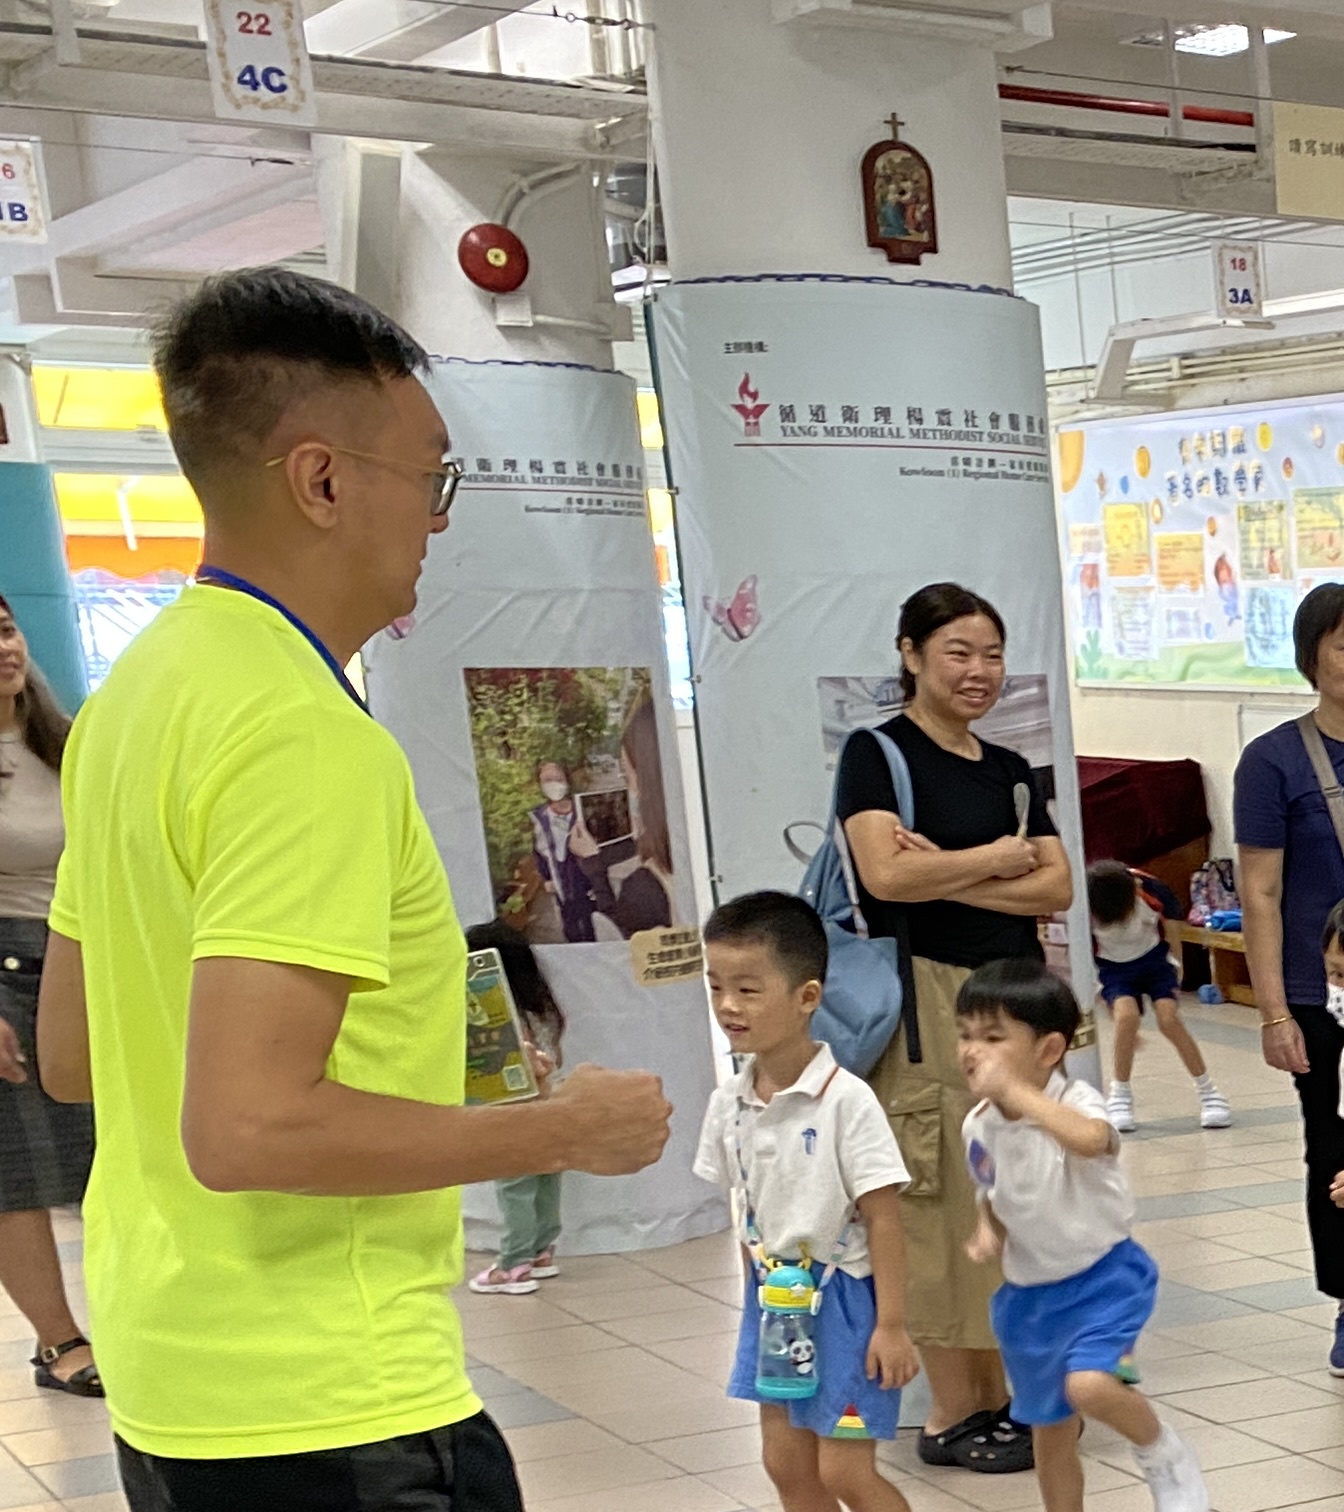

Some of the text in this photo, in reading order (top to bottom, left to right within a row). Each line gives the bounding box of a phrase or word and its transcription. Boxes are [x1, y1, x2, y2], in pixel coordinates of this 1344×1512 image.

[236, 11, 272, 36] 22
[236, 64, 288, 94] 4C
[1230, 257, 1247, 272] 18
[1228, 287, 1253, 305] 3A
[780, 425, 818, 438] YANG
[823, 425, 905, 439] MEMORIAL
[908, 428, 985, 442] METHODIST
